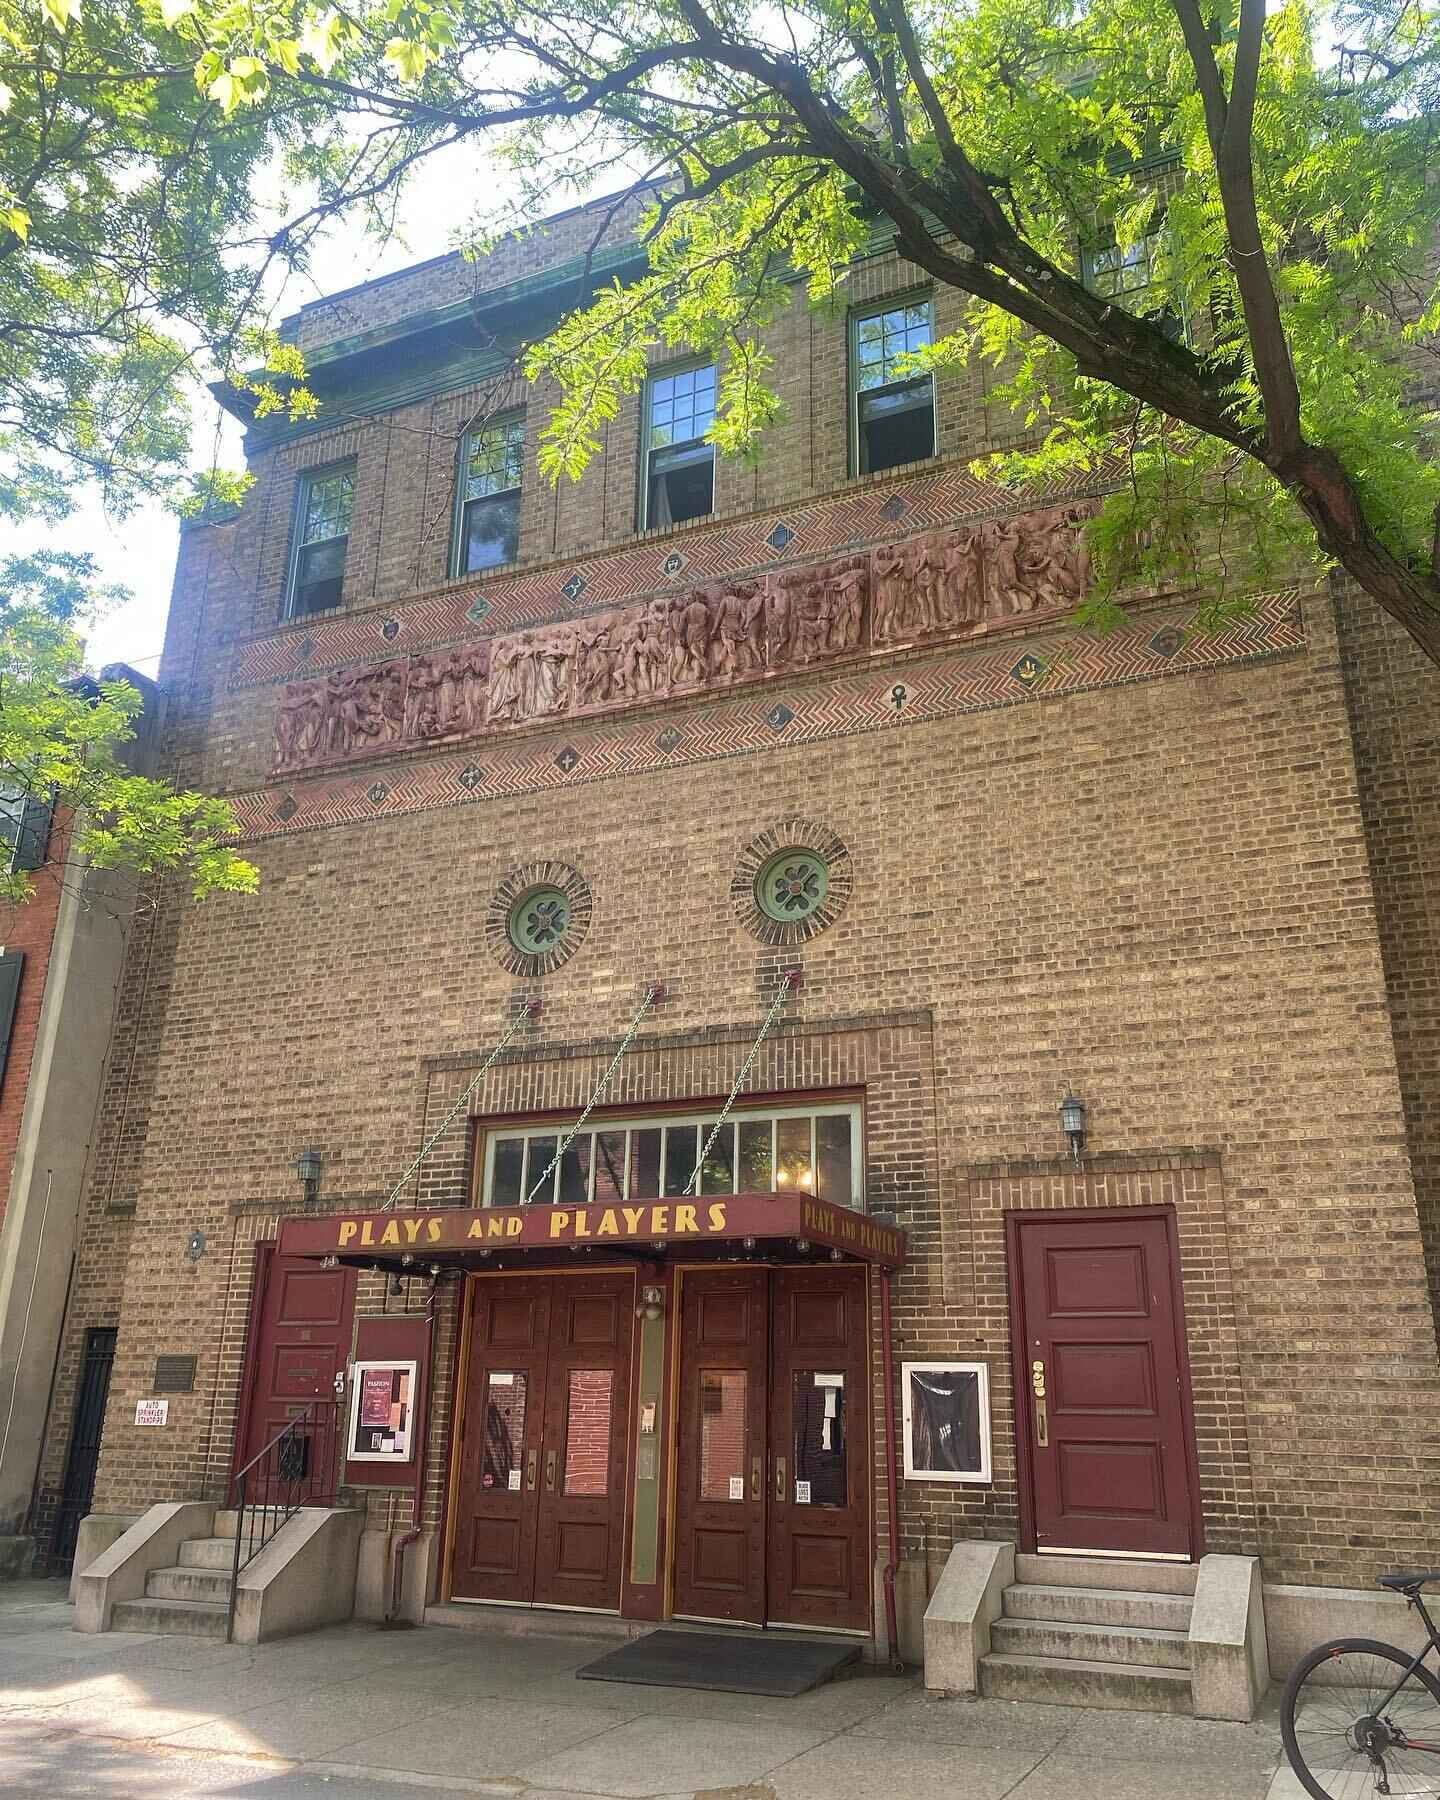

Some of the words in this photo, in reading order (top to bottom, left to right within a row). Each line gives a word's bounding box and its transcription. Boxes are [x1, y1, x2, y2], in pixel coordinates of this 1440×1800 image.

[338, 1218, 443, 1246] PLAYS
[468, 1216, 524, 1239] AND
[550, 1203, 727, 1238] PLAYERS
[805, 1201, 834, 1235] PLAYS
[841, 1216, 856, 1241] AND
[860, 1223, 898, 1257] PLAYERS
[145, 1401, 159, 1409] AUTO
